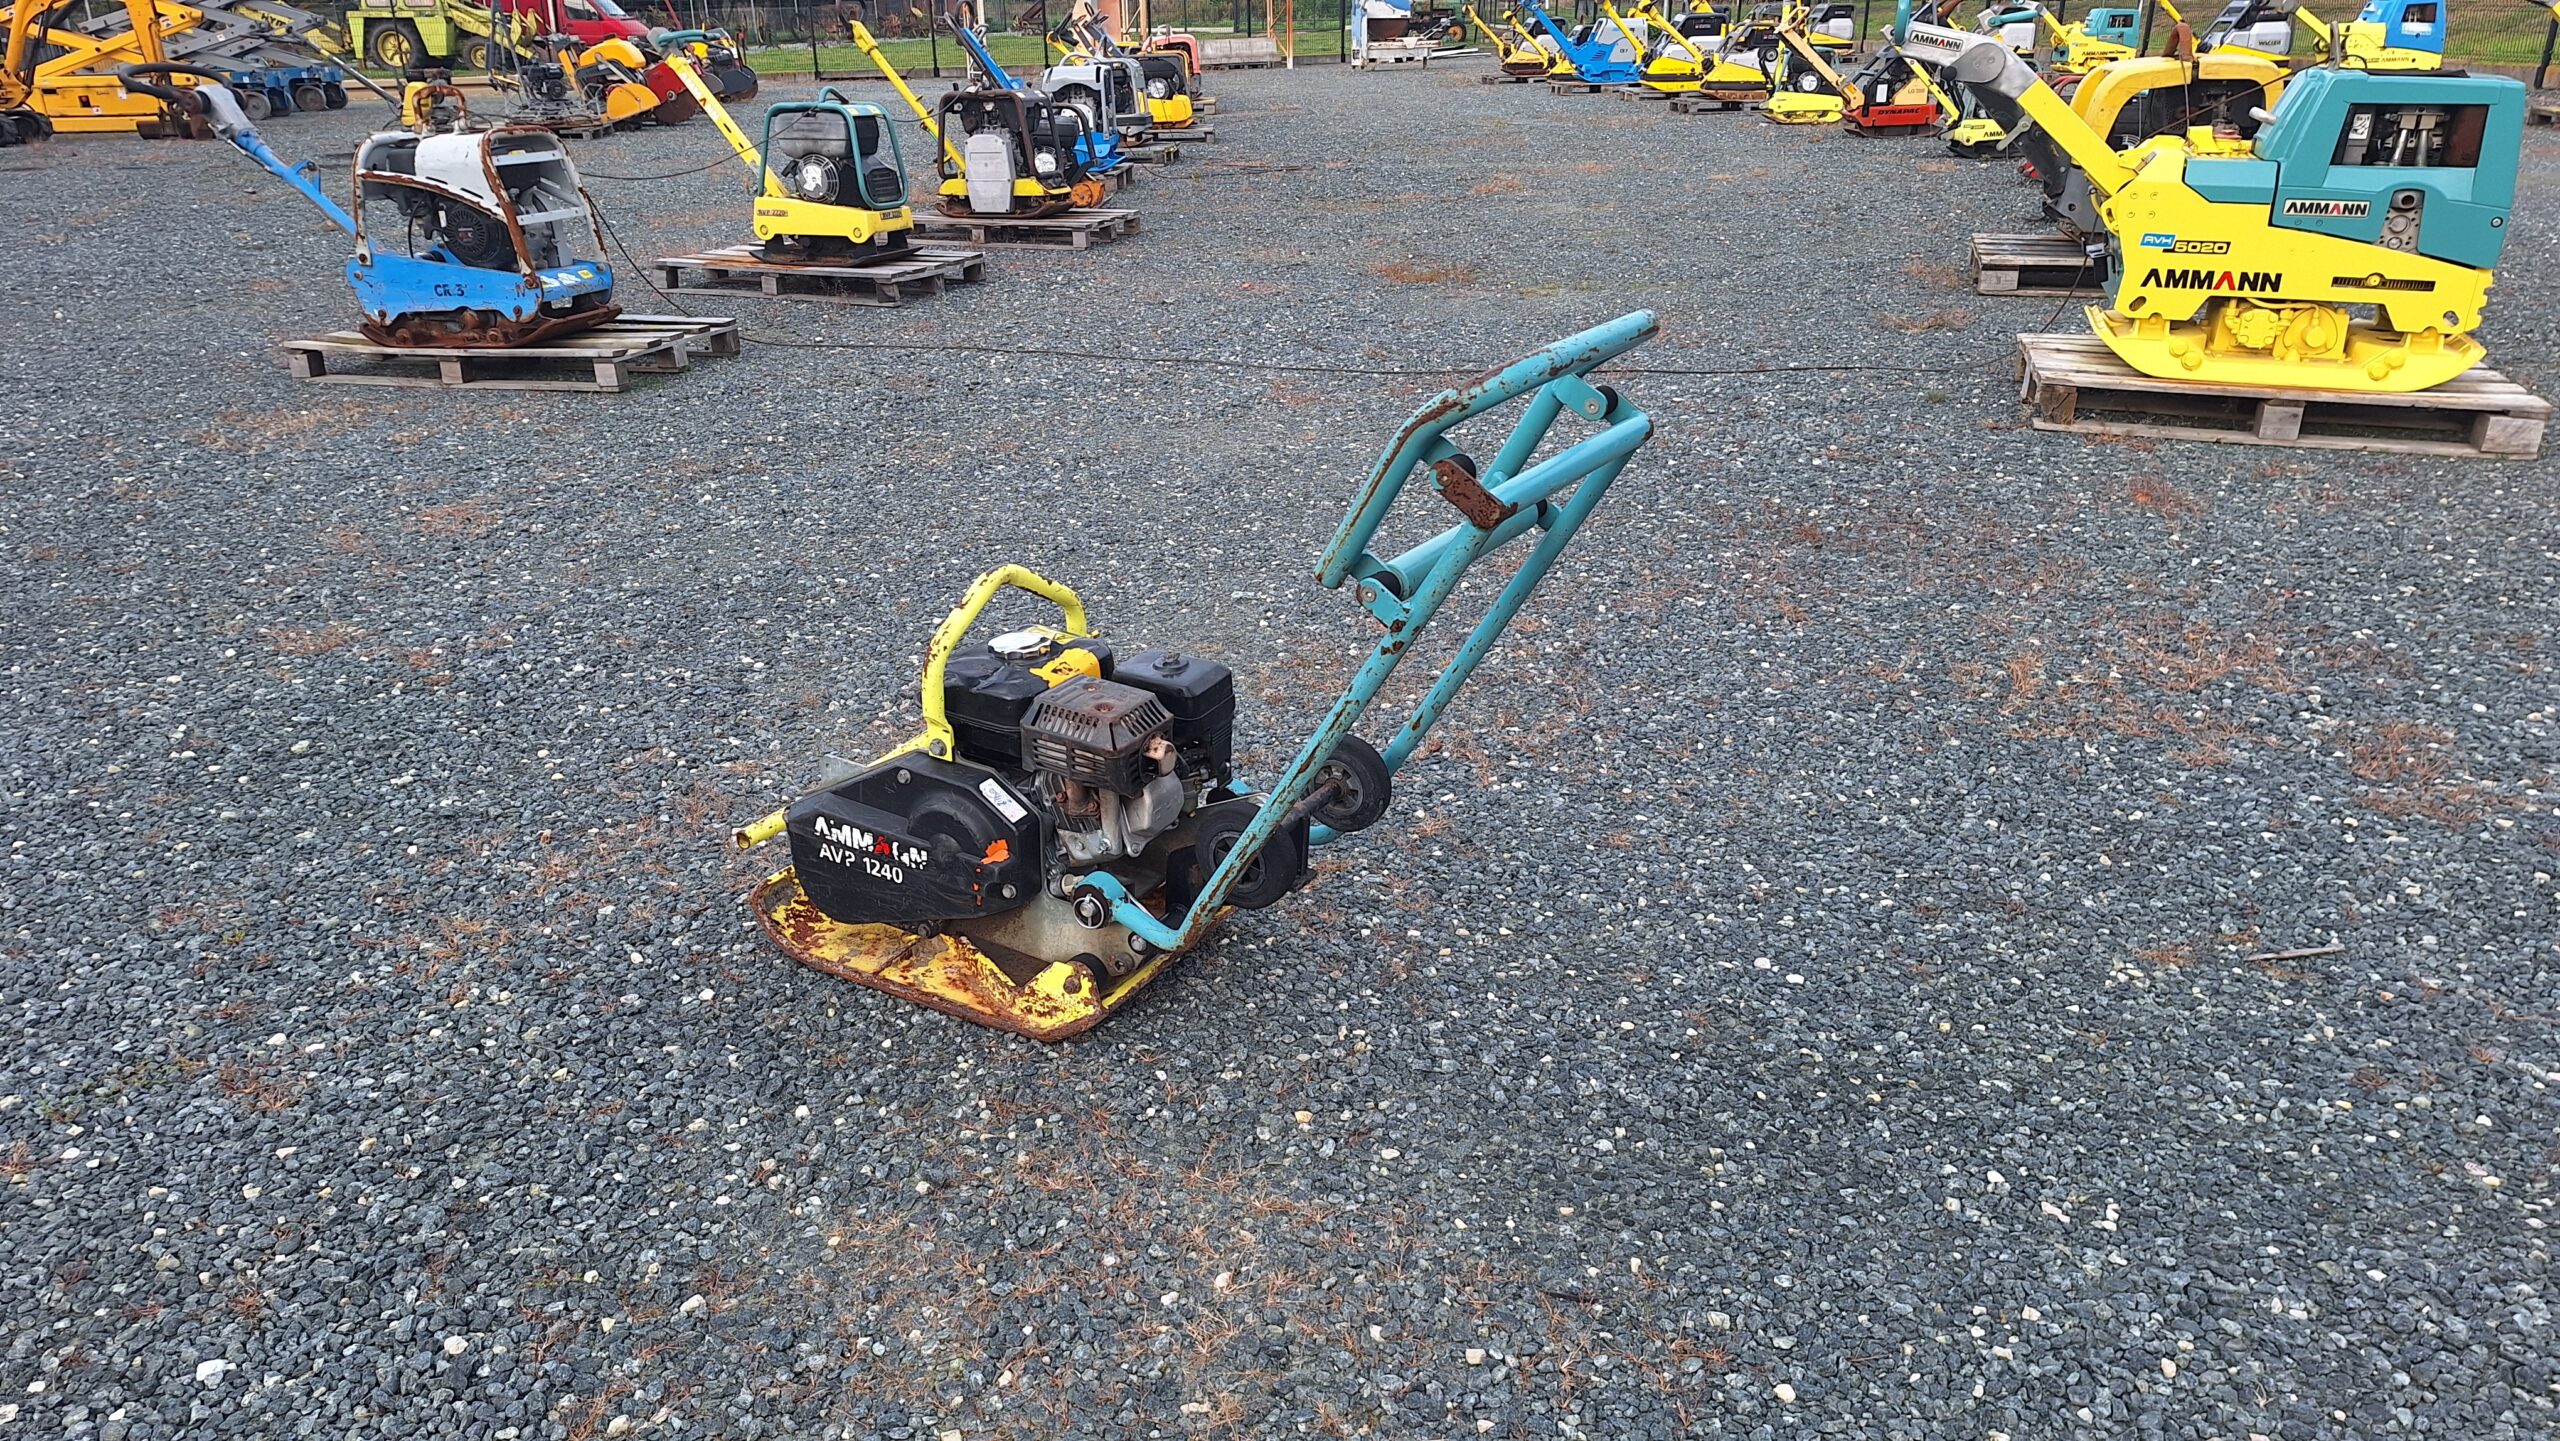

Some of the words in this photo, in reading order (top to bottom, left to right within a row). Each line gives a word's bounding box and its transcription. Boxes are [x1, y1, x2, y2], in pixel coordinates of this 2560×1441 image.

[1912, 33, 1961, 50] AMMANN
[1877, 107, 1921, 115] DYNAPAC
[2286, 202, 2368, 215] AMMANN
[2143, 235, 2173, 245] AVH
[2174, 242, 2228, 254] 5020
[2140, 268, 2283, 293] AMMANN
[863, 856, 904, 884] 1240
